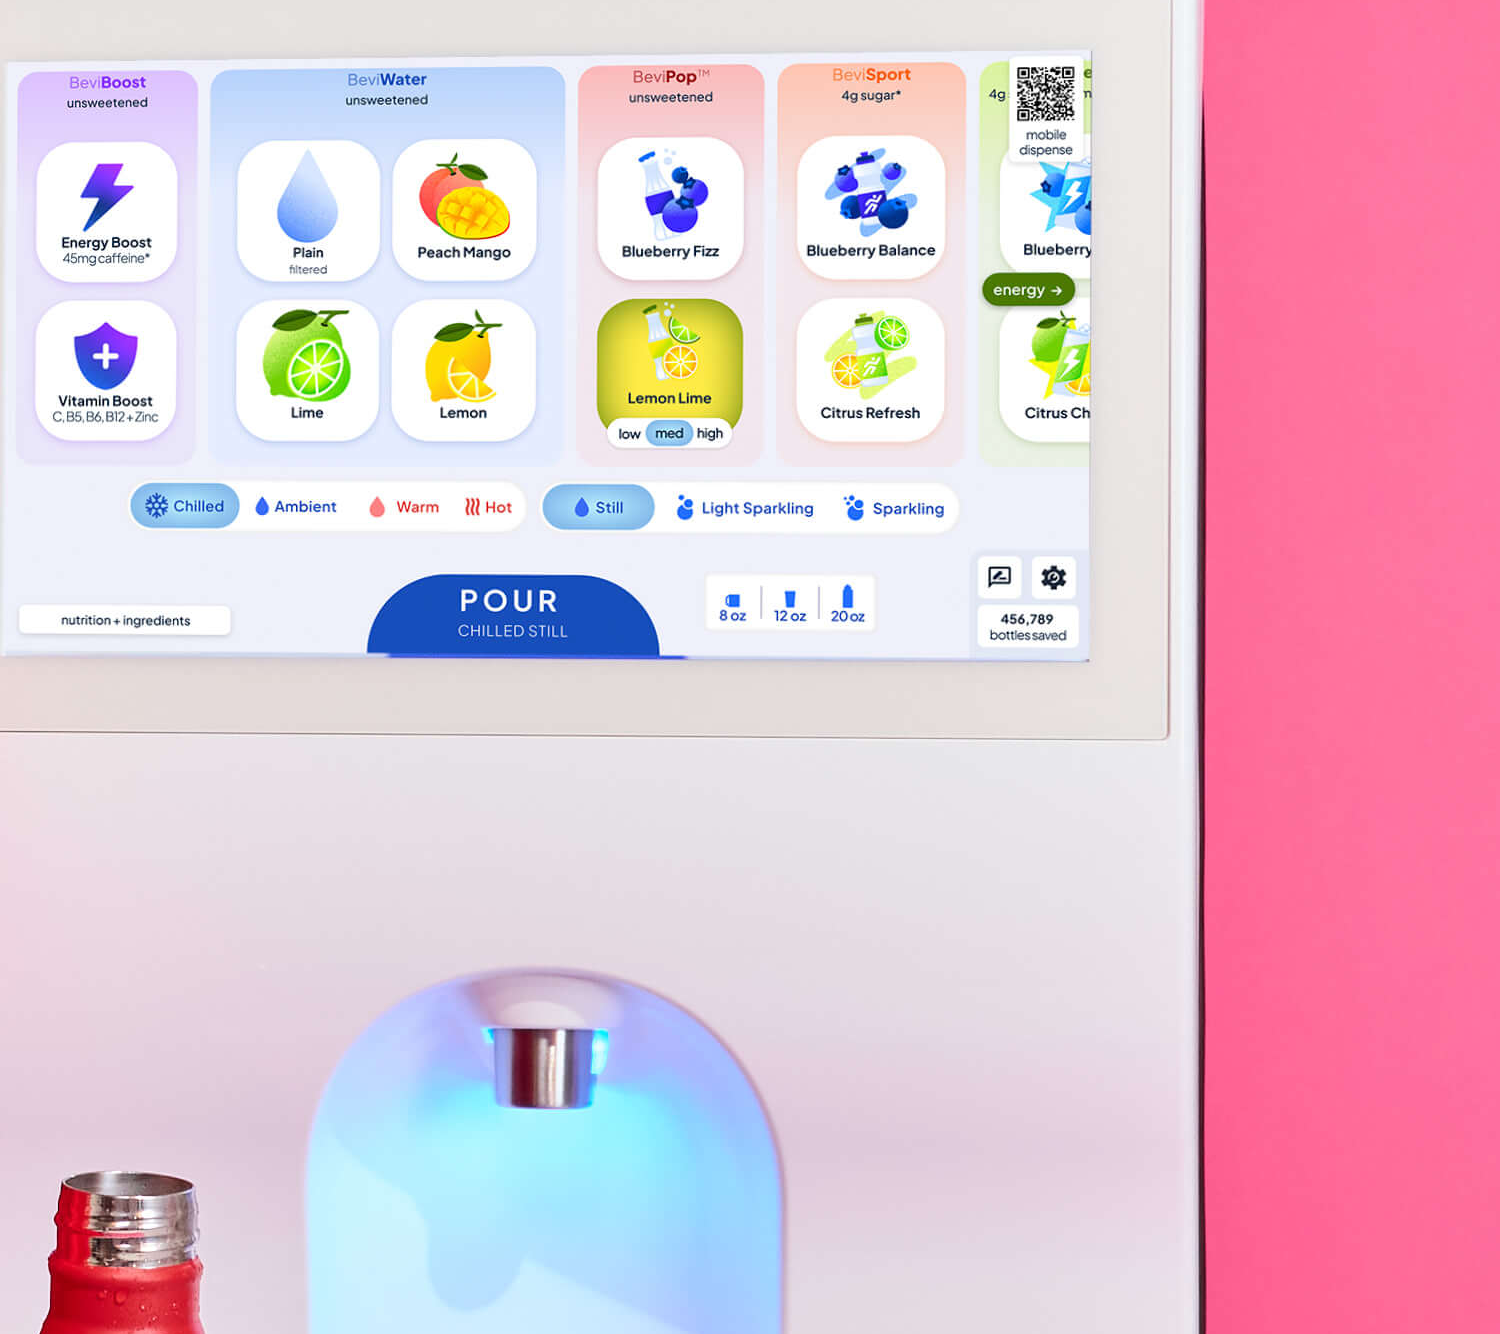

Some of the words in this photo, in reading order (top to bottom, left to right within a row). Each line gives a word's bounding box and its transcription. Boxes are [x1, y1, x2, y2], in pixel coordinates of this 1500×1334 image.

[70, 75, 146, 88] BeviBoost
[349, 73, 427, 86] BeviWater
[833, 68, 911, 83] BeviSport
[346, 94, 428, 105] unsweetened
[629, 92, 713, 103] unsweetened
[842, 91, 858, 103] 4g
[989, 89, 1005, 102] 4g
[67, 97, 148, 108] unsweetened
[1026, 129, 1066, 140] mobile
[1019, 145, 1072, 157] dispense
[62, 237, 108, 251] Energy
[112, 237, 152, 248] Boost
[293, 247, 323, 258] Plain
[418, 247, 460, 258] Peach
[464, 247, 511, 261] Mango
[622, 245, 690, 260] Blueberry
[694, 245, 719, 257] Fizz
[807, 245, 876, 259] Blueberry
[879, 244, 935, 256] Balance
[1024, 243, 1091, 258] Blueberry
[63, 253, 96, 266] 45mg
[289, 265, 327, 274] filtered
[993, 286, 1045, 298] energy
[59, 395, 109, 407] Vitamin
[113, 395, 152, 407] Boost
[628, 392, 675, 404] Lemon
[679, 392, 711, 404] Lime
[106, 411, 125, 422] B12
[135, 411, 158, 422] Zinc
[292, 407, 323, 418] Lime
[440, 407, 487, 418] Lemon
[821, 407, 863, 419] Citrus
[866, 407, 920, 419] Refresh
[1025, 407, 1068, 419] Citrus
[619, 429, 641, 439] low
[656, 428, 683, 438] med
[697, 428, 723, 441] high
[174, 500, 224, 512] Chilled
[275, 501, 336, 512] Ambient
[397, 501, 439, 513] Warm
[486, 501, 512, 513] Hot
[596, 501, 623, 514] Still
[703, 502, 739, 517] Light
[744, 502, 813, 517] Sparkling
[873, 502, 944, 518] Sparkling
[461, 589, 556, 612] POUR
[62, 615, 111, 625] nutrition
[123, 615, 190, 628] ingredients
[720, 610, 727, 621] 8
[731, 612, 746, 621] oz
[774, 610, 788, 621] 12
[791, 613, 807, 622] oz
[832, 611, 848, 622] 20
[850, 613, 864, 622] oz
[1001, 614, 1053, 626] 456,789
[458, 624, 524, 637] CHILLED
[529, 625, 568, 637] STILL
[990, 630, 1031, 640] bottles
[1032, 630, 1067, 641] saved
